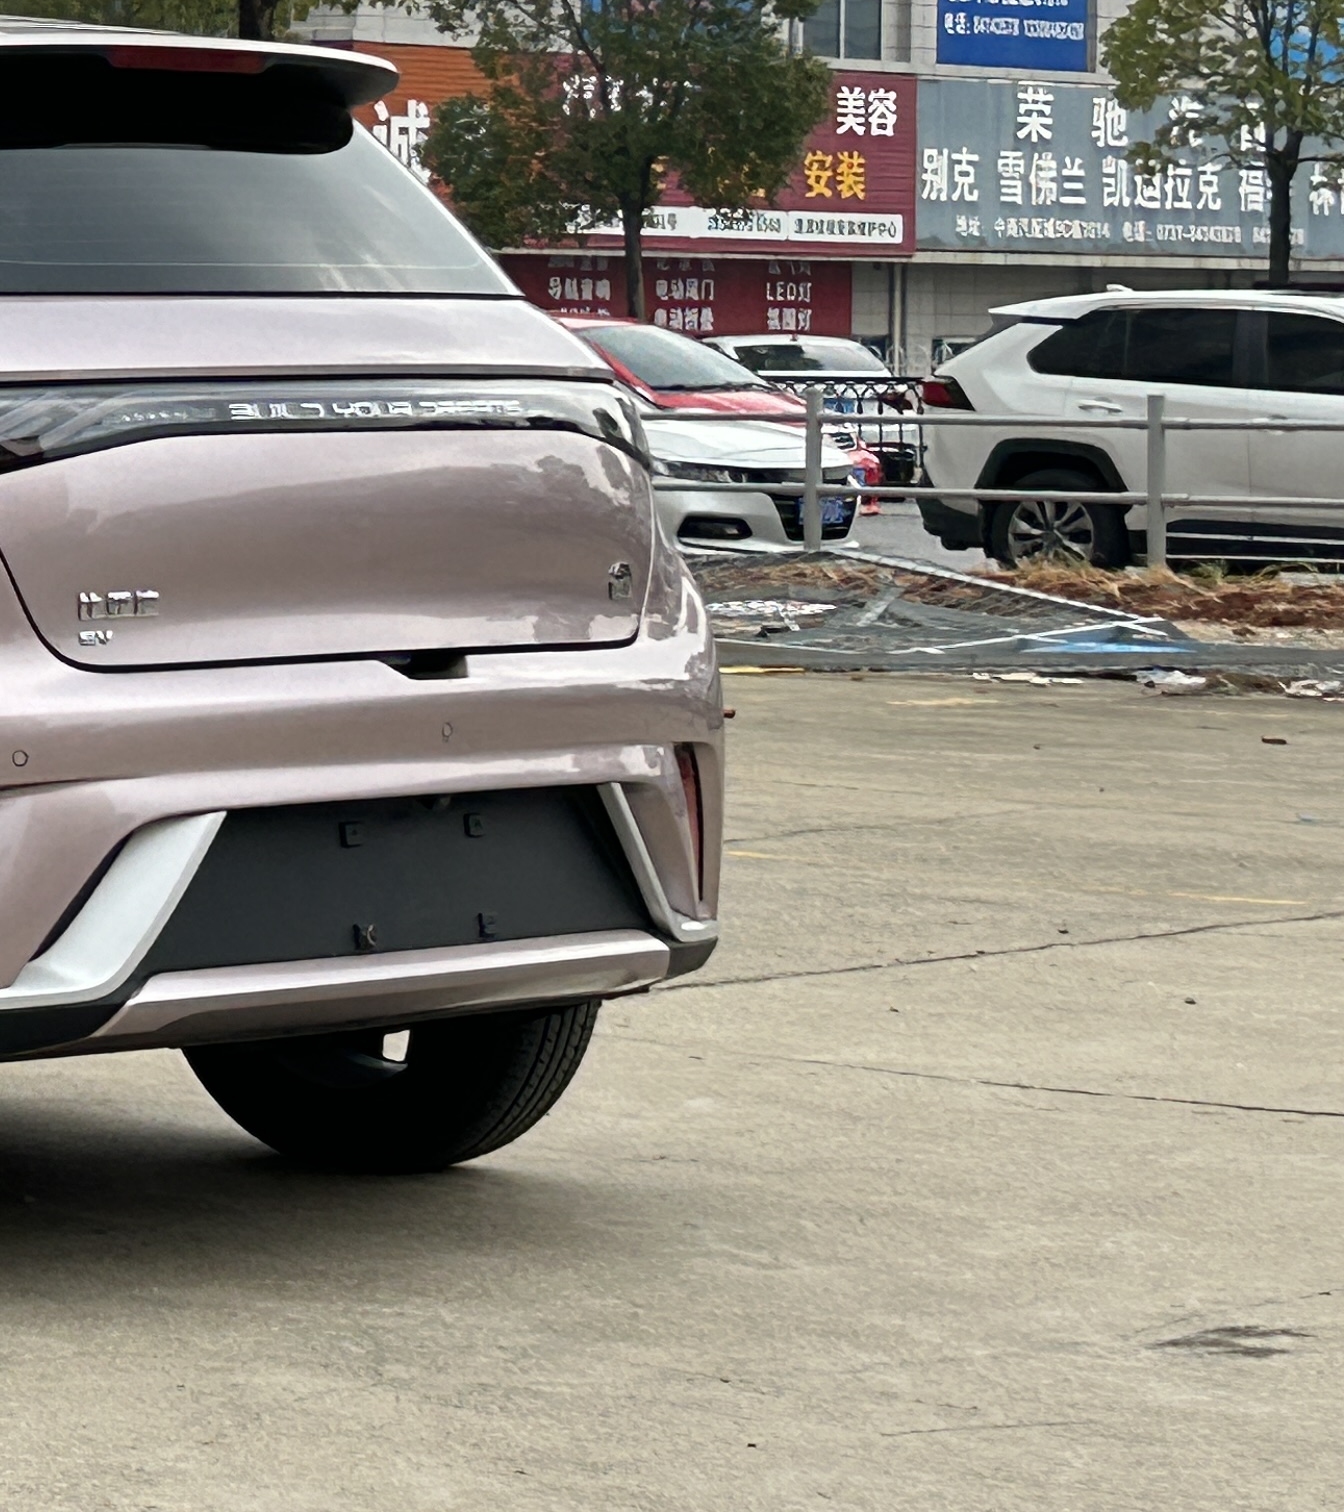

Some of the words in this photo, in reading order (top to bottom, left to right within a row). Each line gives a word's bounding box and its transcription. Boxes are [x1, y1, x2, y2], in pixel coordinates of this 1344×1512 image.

[836, 86, 898, 136] 美容
[804, 150, 867, 200] 安装
[921, 147, 980, 202] 别克
[997, 150, 1087, 206] 雪佛兰
